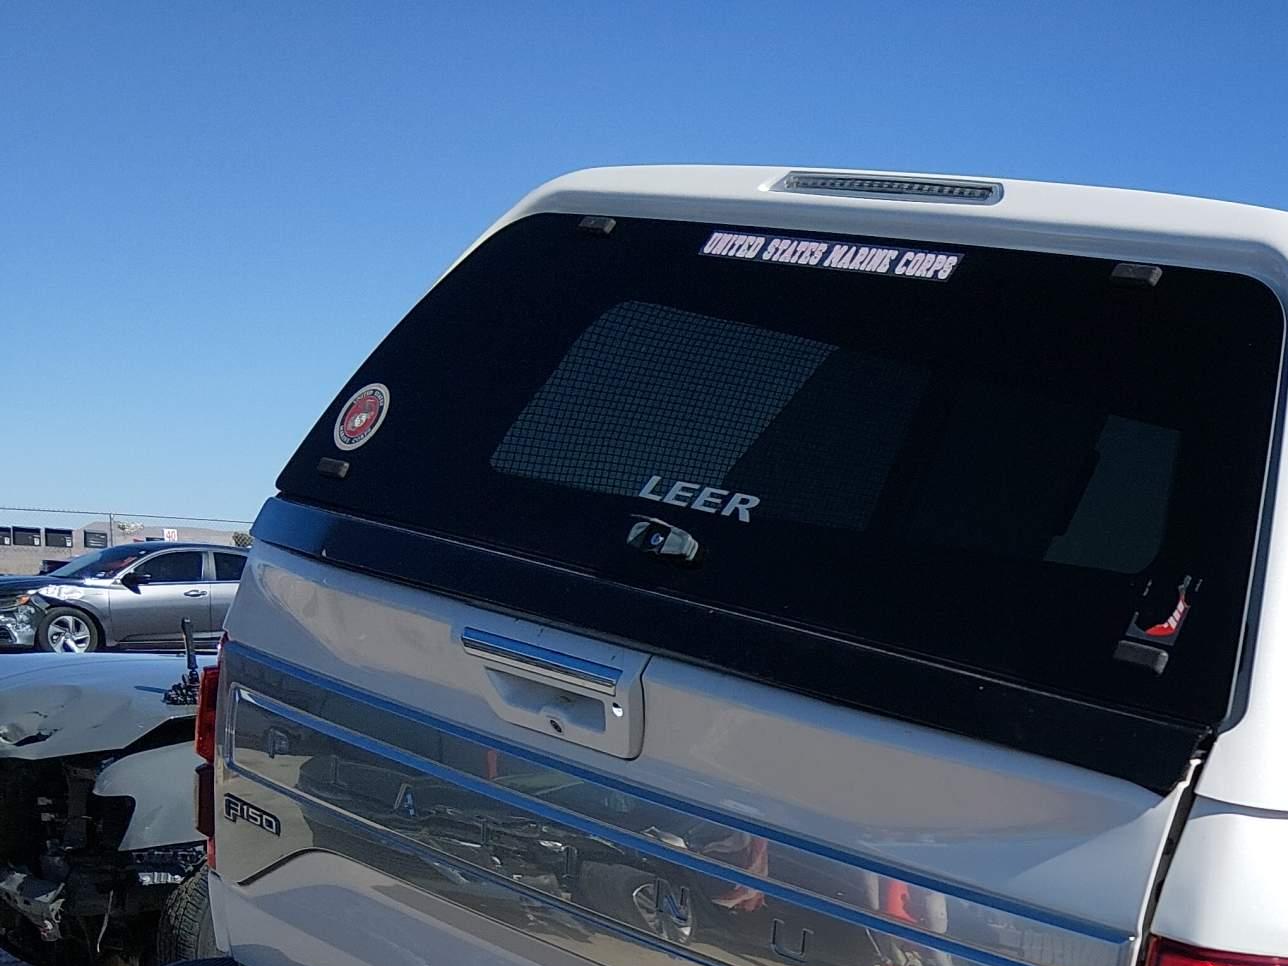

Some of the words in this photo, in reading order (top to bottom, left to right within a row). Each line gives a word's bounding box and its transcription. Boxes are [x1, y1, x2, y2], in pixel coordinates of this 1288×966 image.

[702, 232, 766, 259] UNITED
[762, 238, 828, 266] STATES
[823, 243, 899, 273] MARINE
[895, 251, 959, 280] CORPS
[638, 475, 760, 522] LEER
[223, 793, 281, 836] F150
